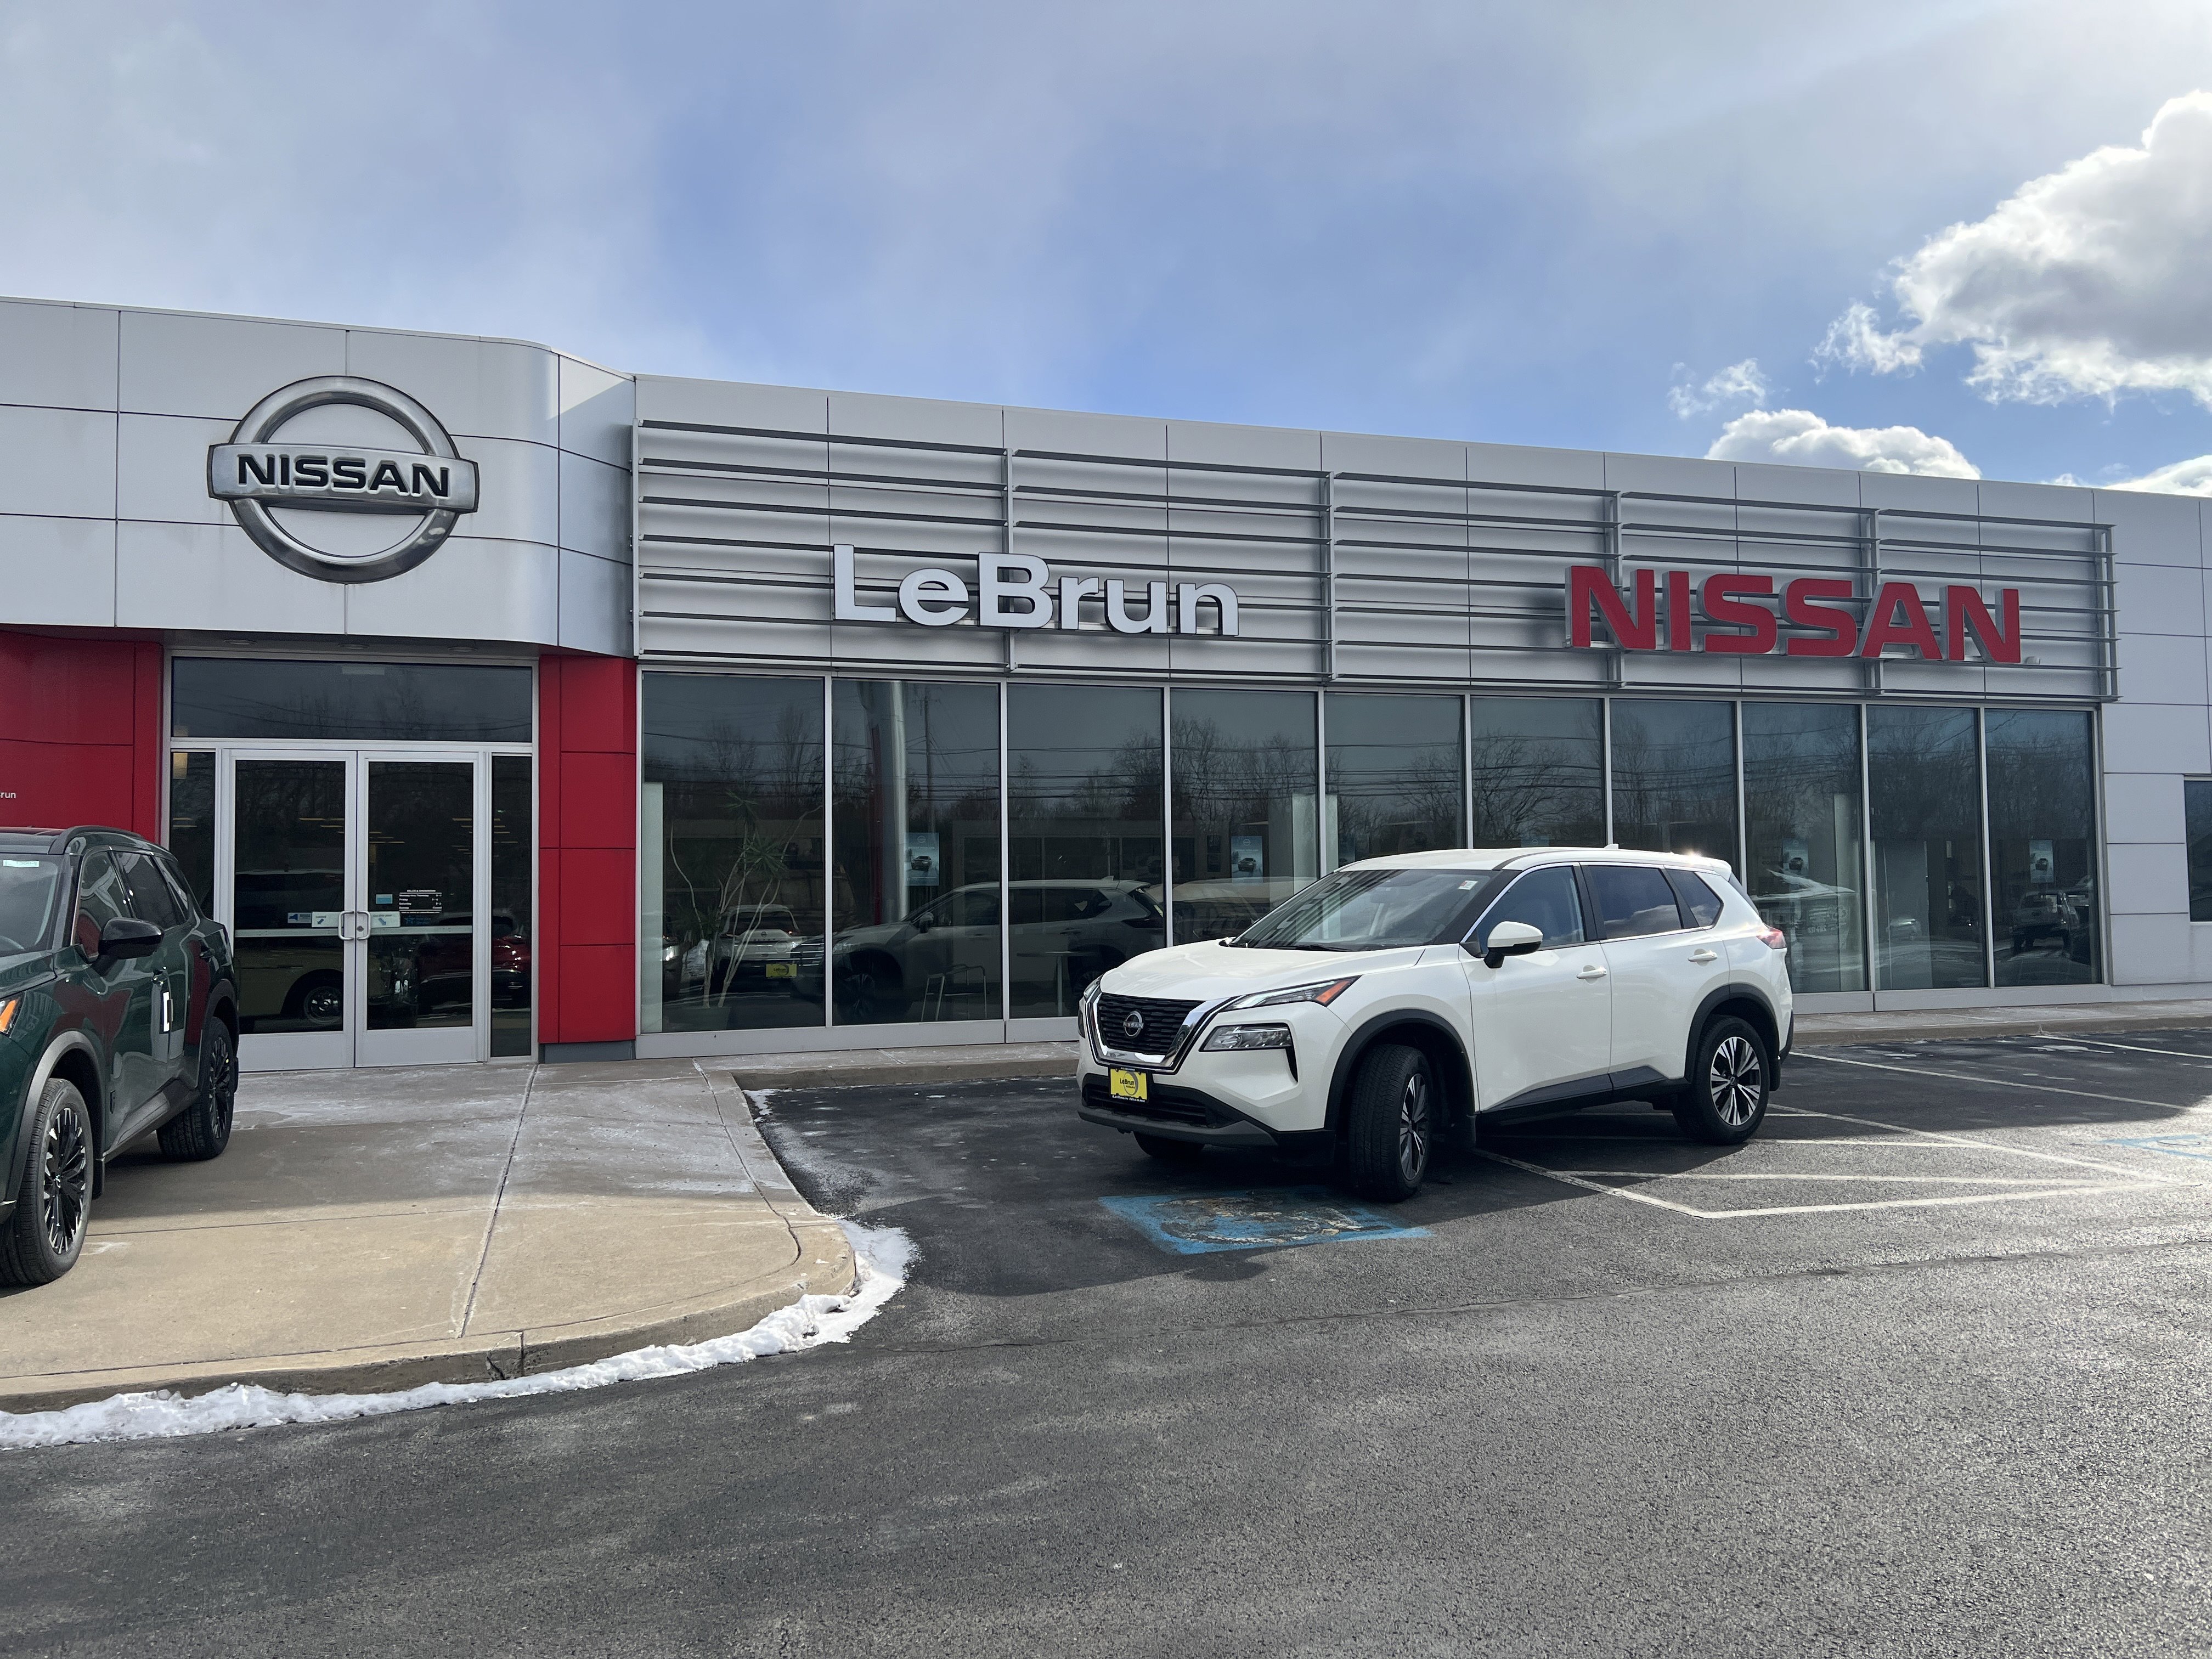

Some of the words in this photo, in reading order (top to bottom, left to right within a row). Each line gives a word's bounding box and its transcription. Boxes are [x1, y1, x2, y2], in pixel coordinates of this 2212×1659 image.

[238, 455, 449, 498] NISSAN
[833, 544, 1239, 636] LeBrun
[1565, 565, 2021, 663] NISSAN
